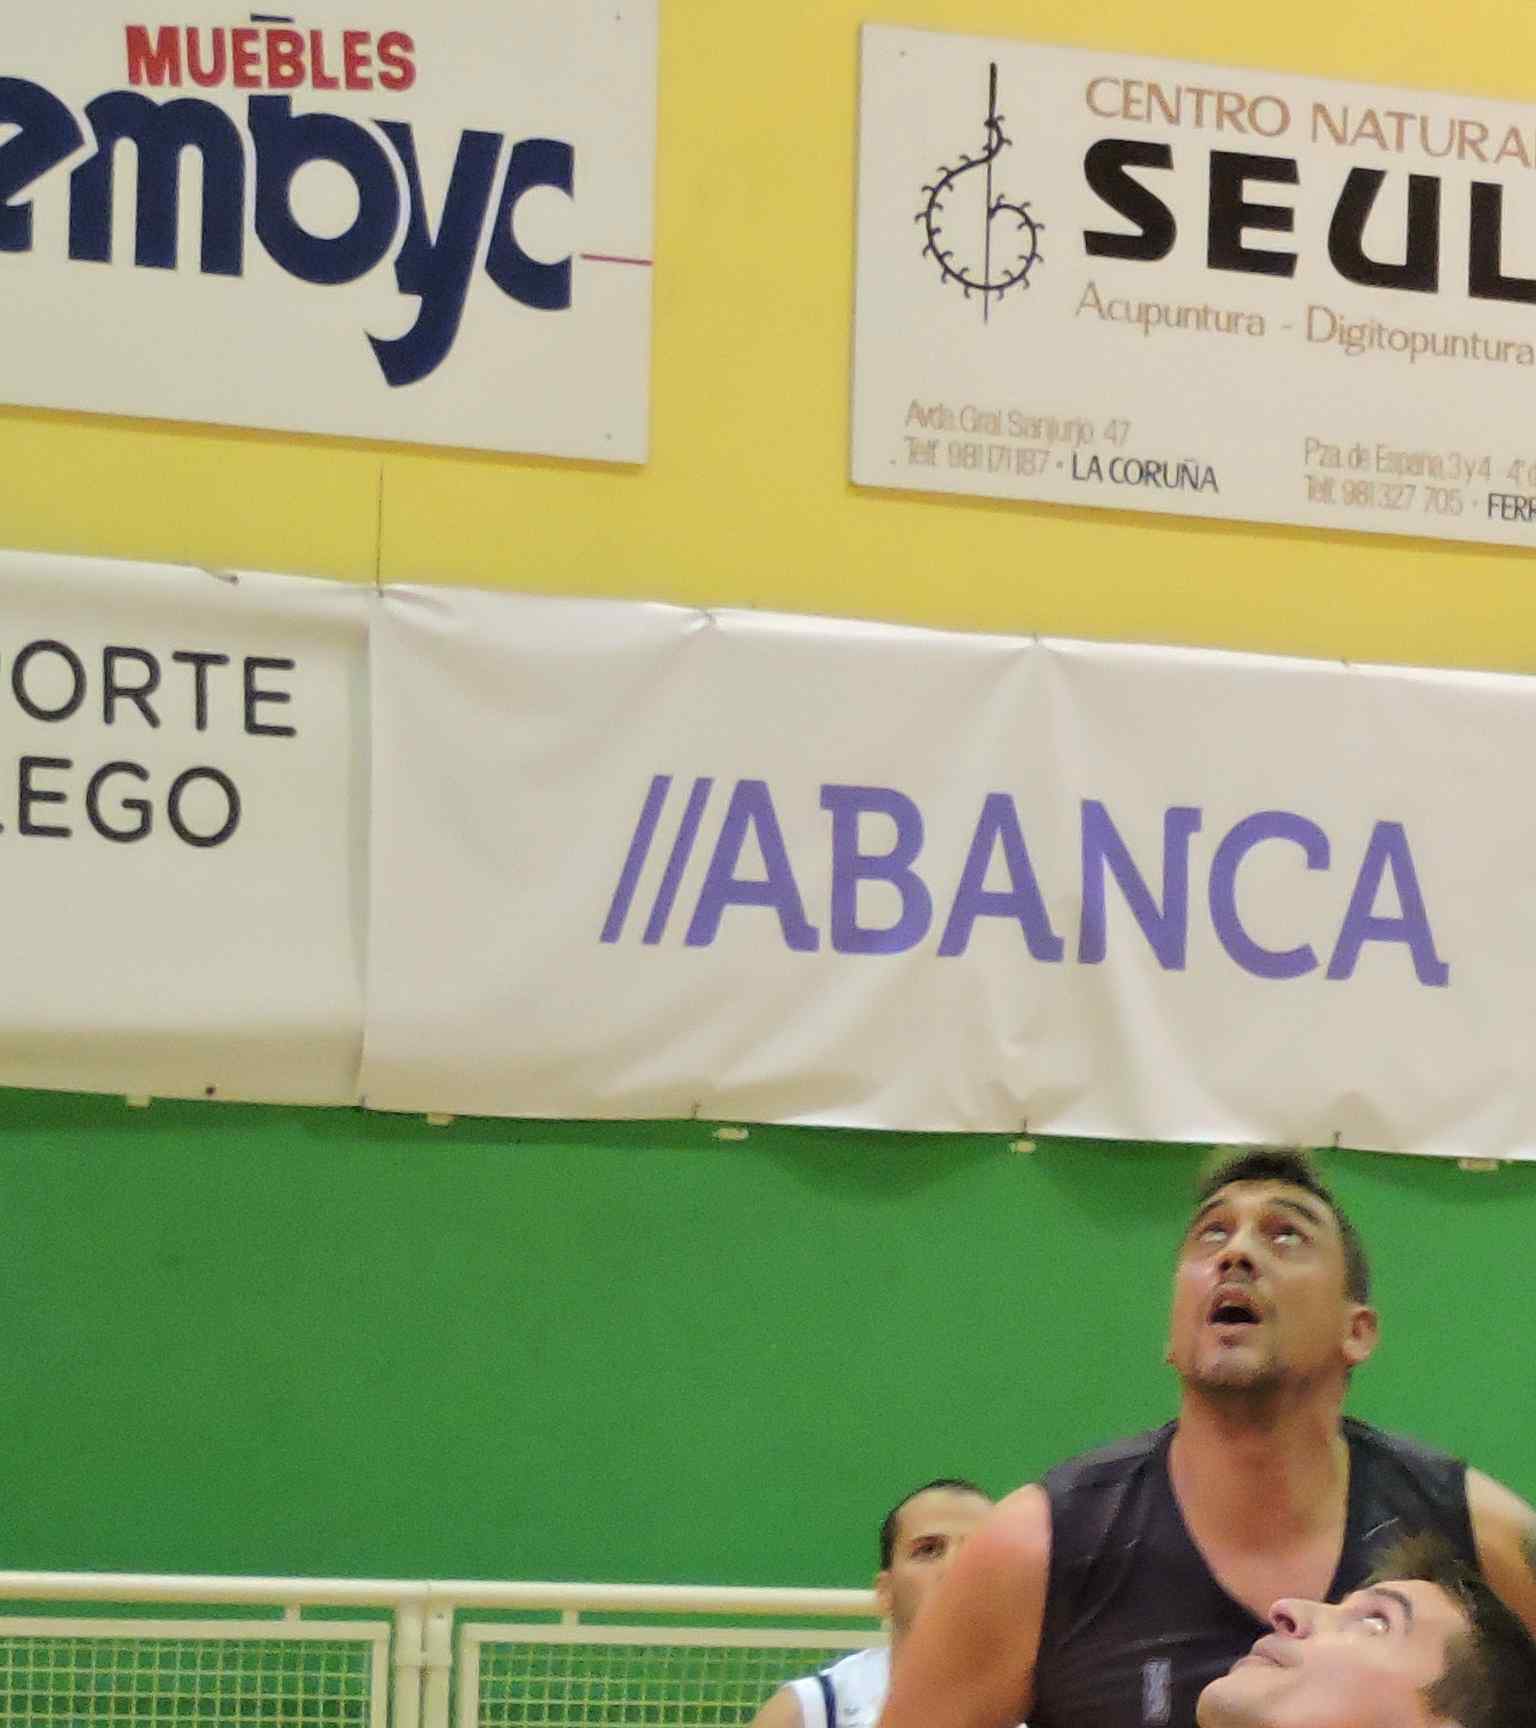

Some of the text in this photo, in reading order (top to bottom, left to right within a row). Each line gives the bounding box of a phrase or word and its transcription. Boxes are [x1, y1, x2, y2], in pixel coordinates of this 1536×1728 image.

[125, 25, 417, 91] MUEBLES
[1085, 77, 1292, 137] CENTRO
[1076, 281, 1266, 337] Acupuntura
[1306, 305, 1536, 366] Digitopuntura
[1072, 452, 1103, 483] LA
[1108, 456, 1220, 493] CORUÑA
